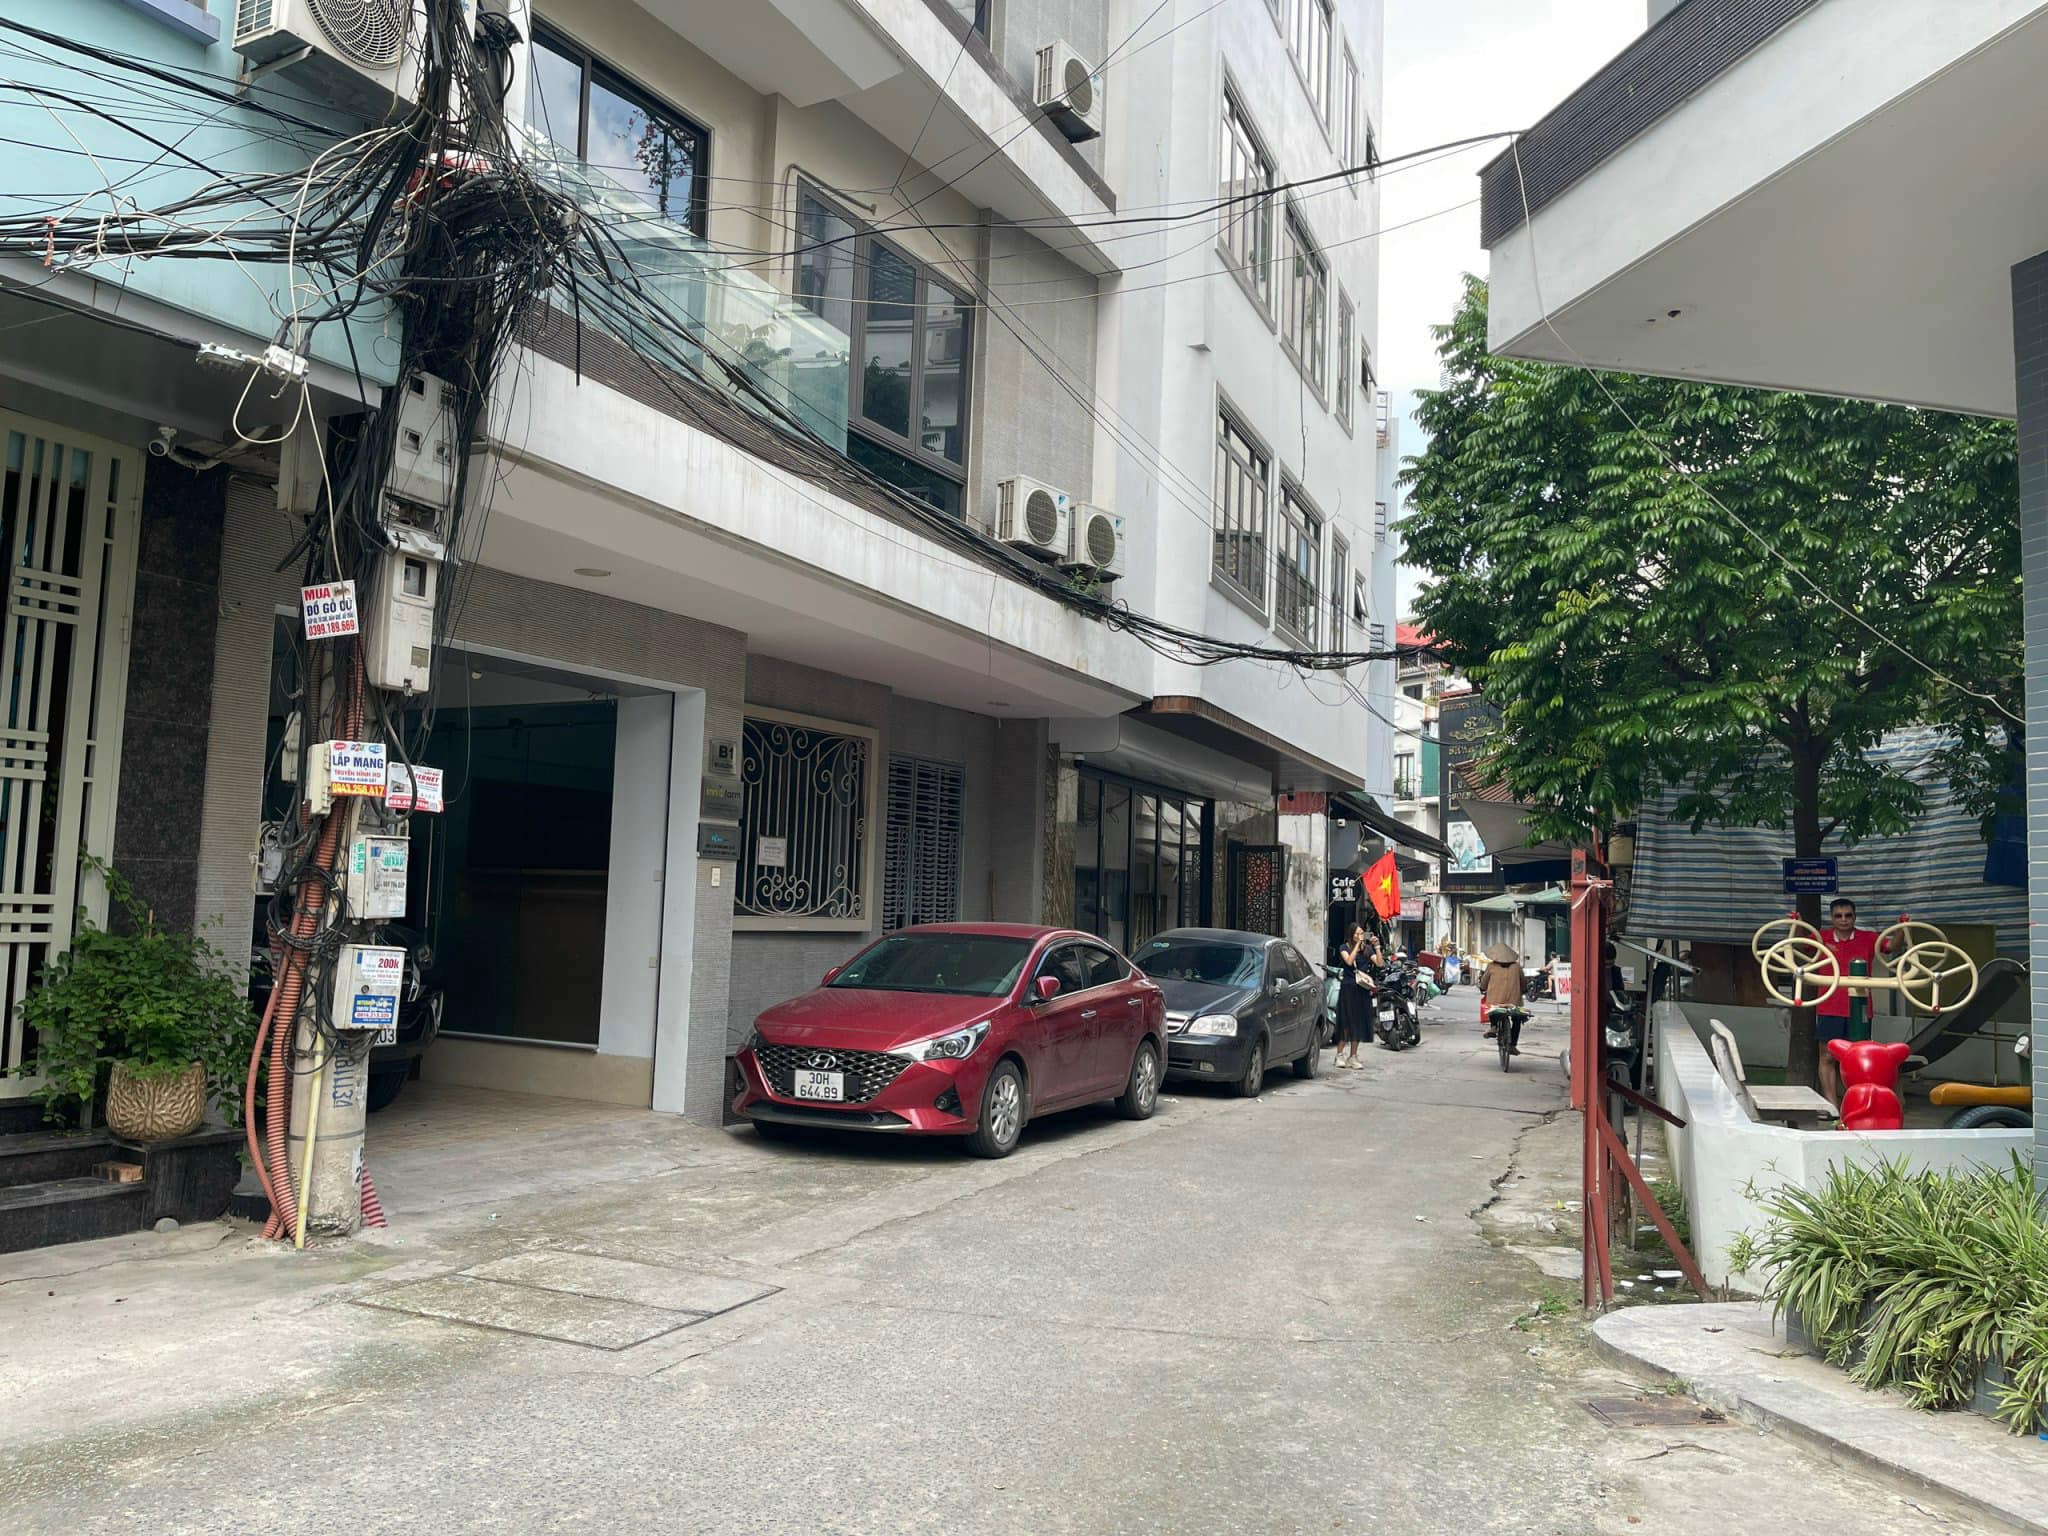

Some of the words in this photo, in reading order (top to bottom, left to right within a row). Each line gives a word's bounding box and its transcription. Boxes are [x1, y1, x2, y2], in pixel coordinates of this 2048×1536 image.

[304, 587, 331, 602] MUA
[323, 598, 337, 615] GỖ
[719, 744, 734, 761] B1
[332, 752, 351, 768] LẮP
[353, 757, 384, 771] MẠNG
[1332, 877, 1356, 887] Cafe
[1332, 887, 1356, 901] 11
[378, 958, 400, 969] 200k
[808, 1072, 830, 1086] 30H
[800, 1084, 838, 1099] 644.89
